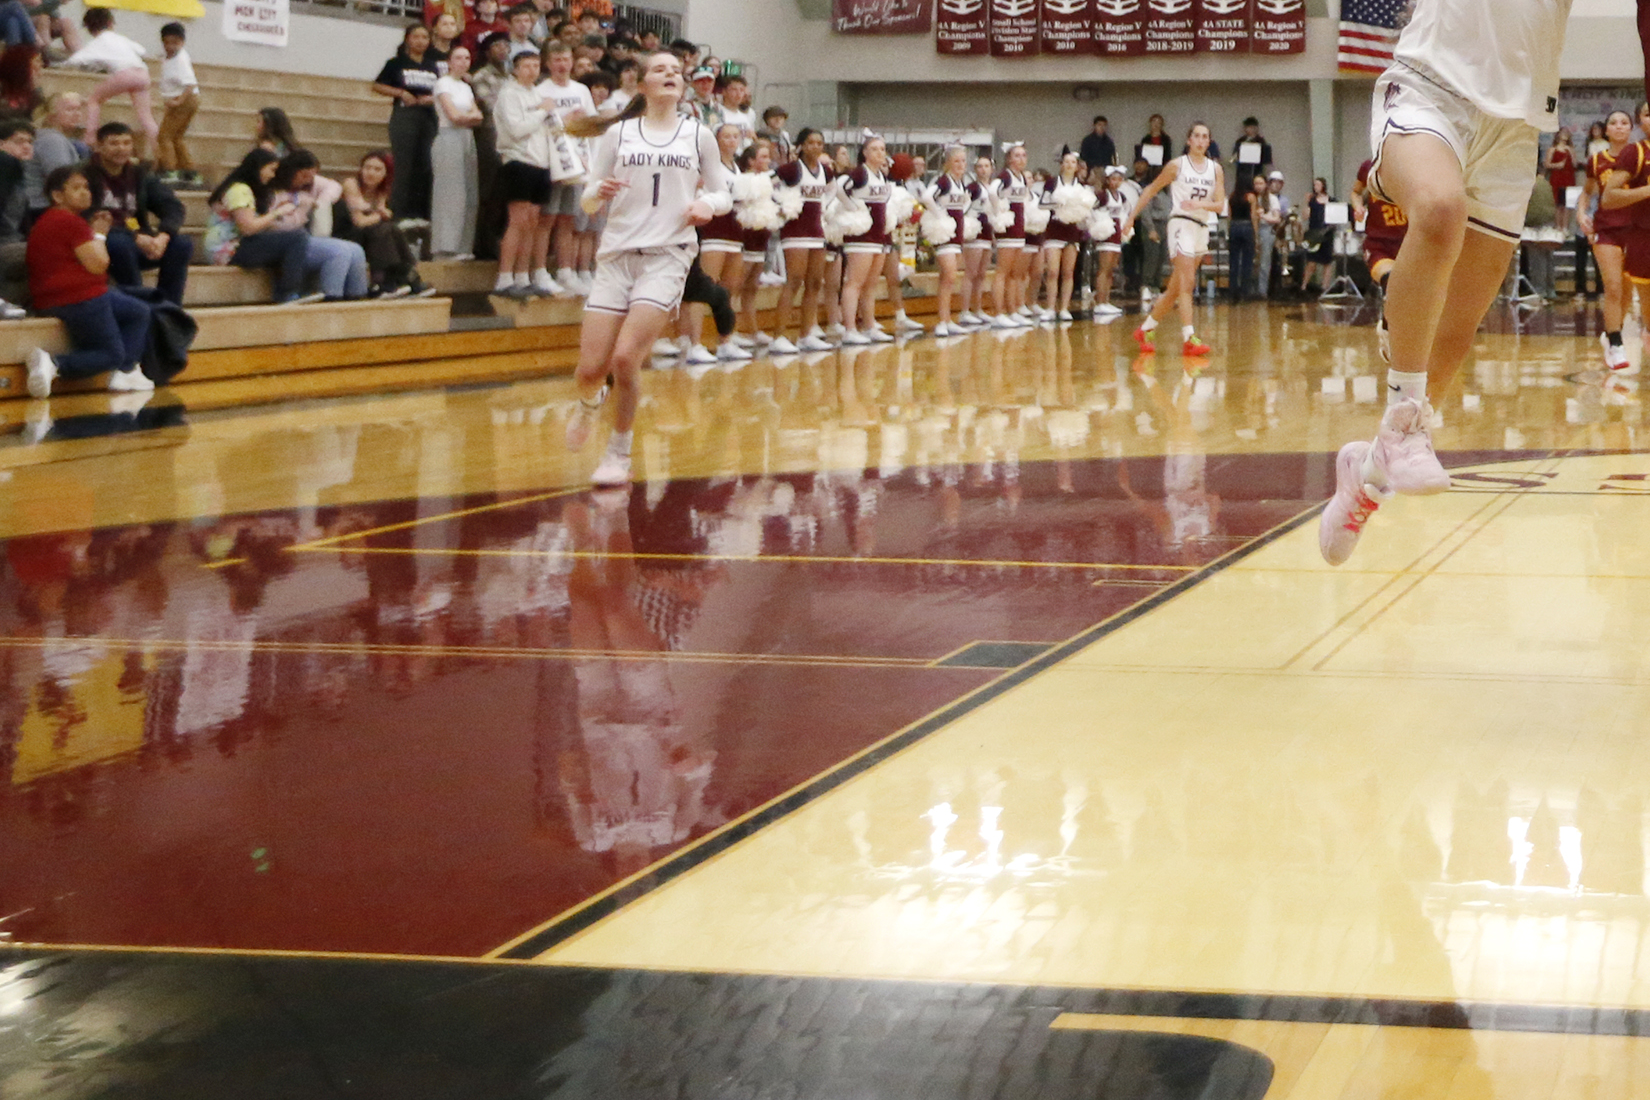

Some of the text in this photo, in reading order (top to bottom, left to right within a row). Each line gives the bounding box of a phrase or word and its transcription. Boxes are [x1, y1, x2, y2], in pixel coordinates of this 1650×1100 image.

[951, 20, 986, 32] Region V
[1012, 18, 1036, 26] School
[1055, 20, 1091, 31] Region V
[1105, 22, 1142, 32] Region V
[1158, 19, 1183, 30] Region
[1184, 19, 1193, 28] V
[1215, 20, 1244, 28] STATE
[1267, 21, 1292, 31] Region
[938, 31, 986, 40] Champions
[1043, 30, 1091, 40] Champions
[1095, 32, 1142, 43] Champions
[1146, 30, 1194, 40] Champions
[1198, 29, 1248, 39] Champions
[1004, 43, 1024, 52] 2010
[1056, 40, 1075, 49] 2010
[1147, 41, 1194, 50] 2018-2019
[1210, 40, 1236, 50] 2019
[622, 153, 691, 170] LADY KINGS
[652, 172, 660, 207] 1
